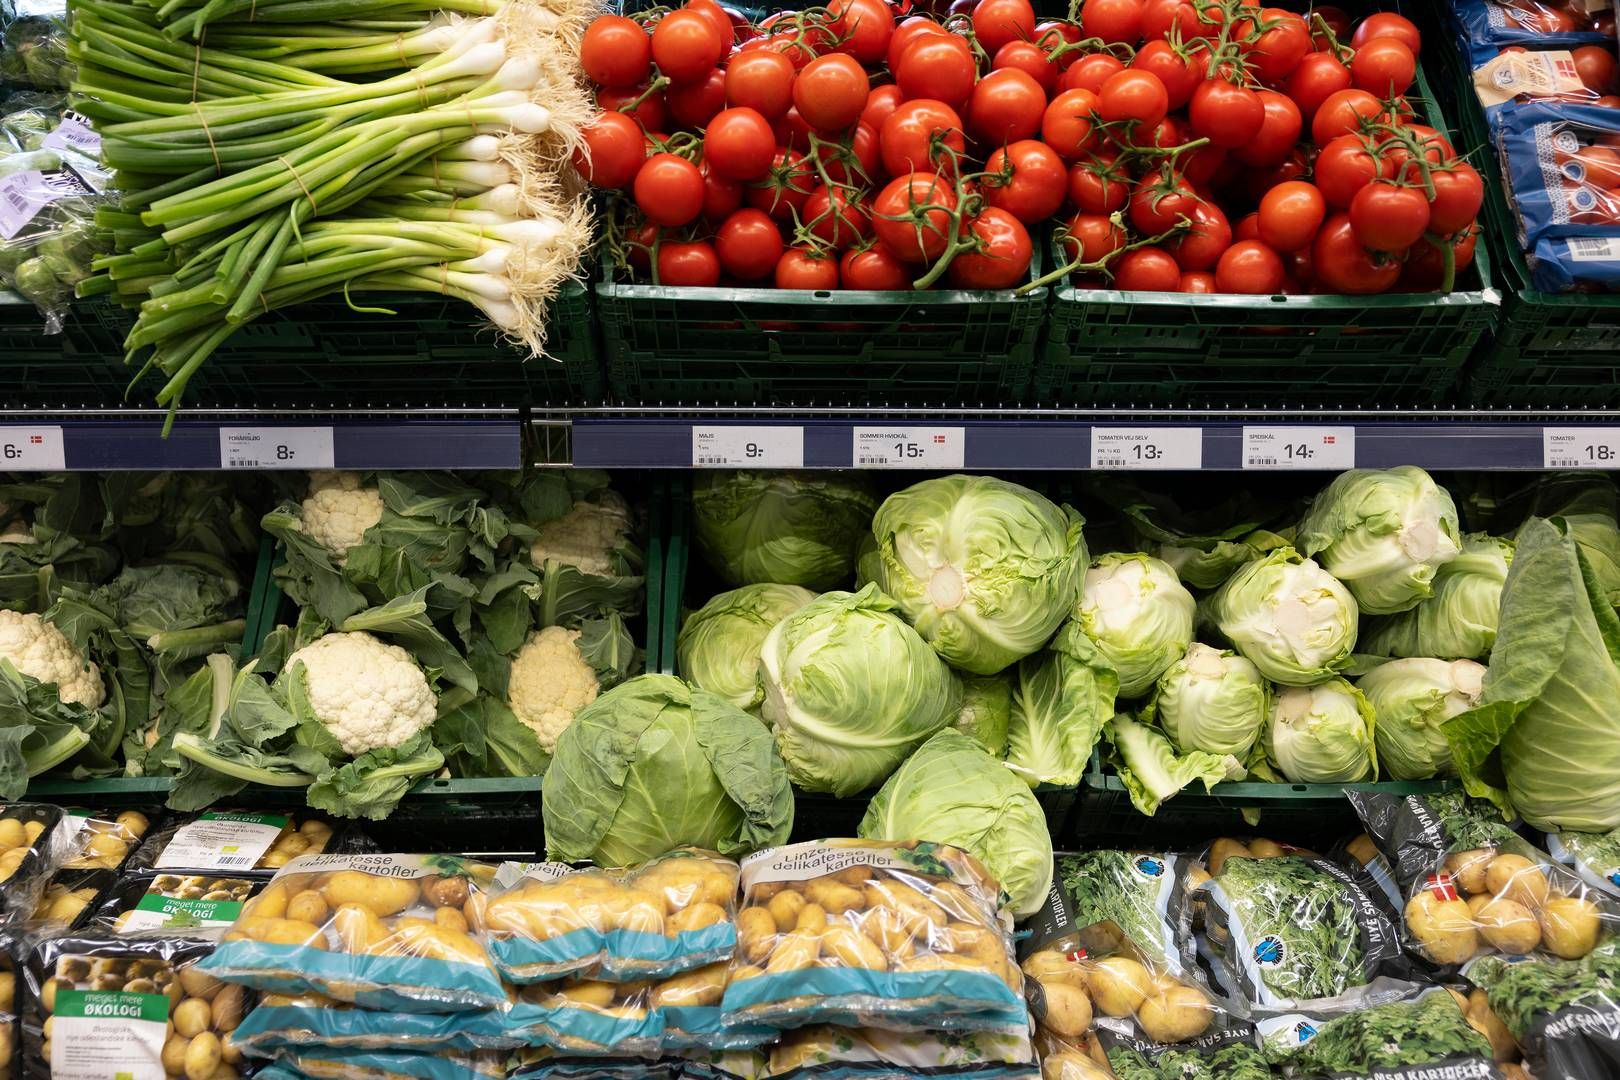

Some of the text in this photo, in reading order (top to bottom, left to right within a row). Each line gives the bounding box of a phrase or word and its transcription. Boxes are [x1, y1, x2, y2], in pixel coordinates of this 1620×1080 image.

[772, 850, 865, 871] delikatesse
[825, 854, 894, 873] kartofler
[348, 861, 419, 878] kartofler
[162, 904, 214, 919] ØKOGI
[1366, 918, 1382, 943] NYE
[84, 1004, 142, 1017] ØKOLOGI
[1223, 1028, 1250, 1039] NYE
